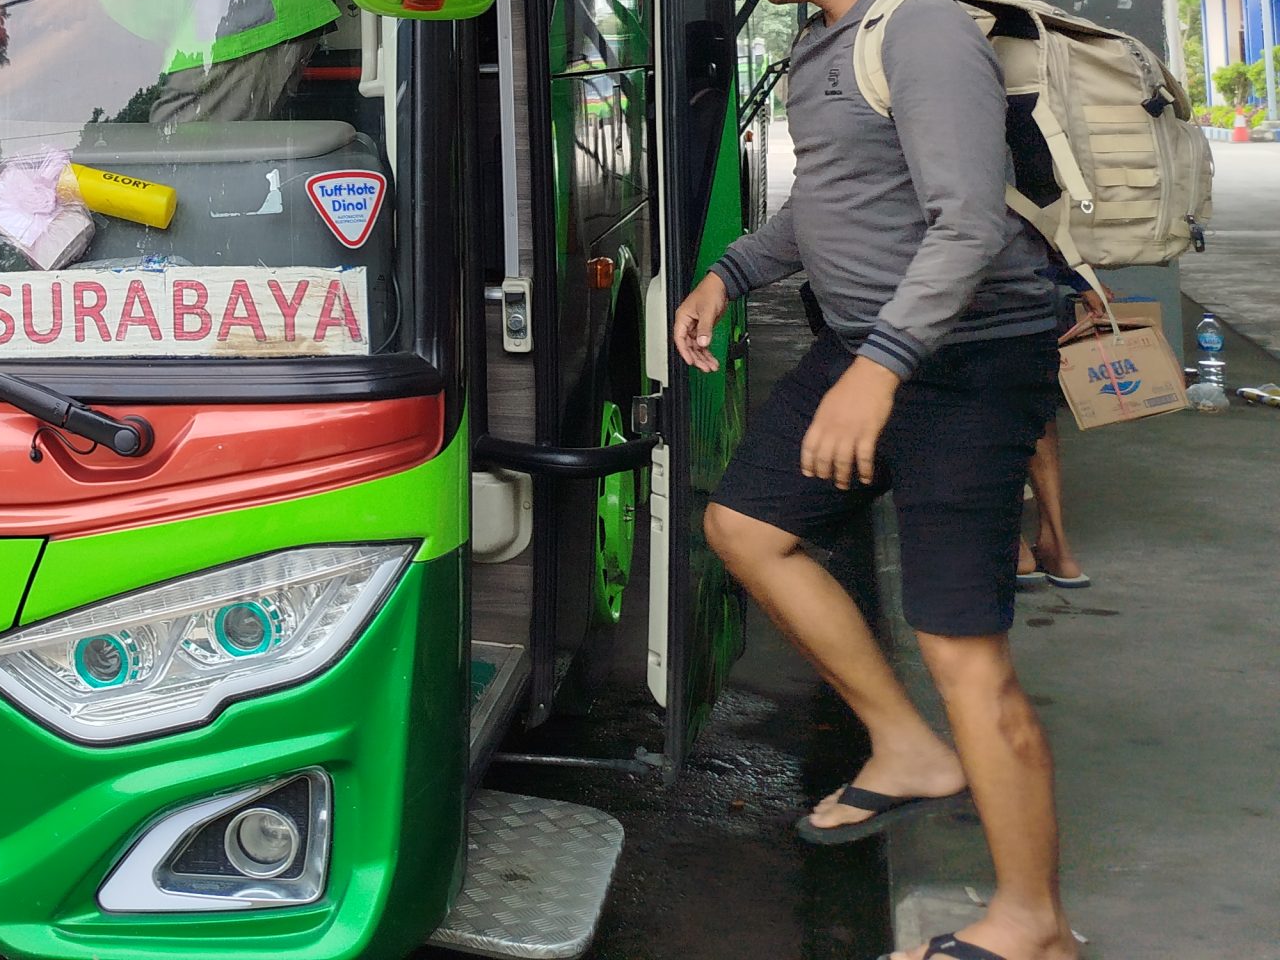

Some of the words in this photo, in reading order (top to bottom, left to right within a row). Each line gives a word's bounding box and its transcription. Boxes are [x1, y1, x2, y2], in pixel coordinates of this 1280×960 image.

[102, 172, 152, 190] GLORY
[318, 182, 376, 197] Tuff-Kote
[331, 197, 368, 212] Dinol
